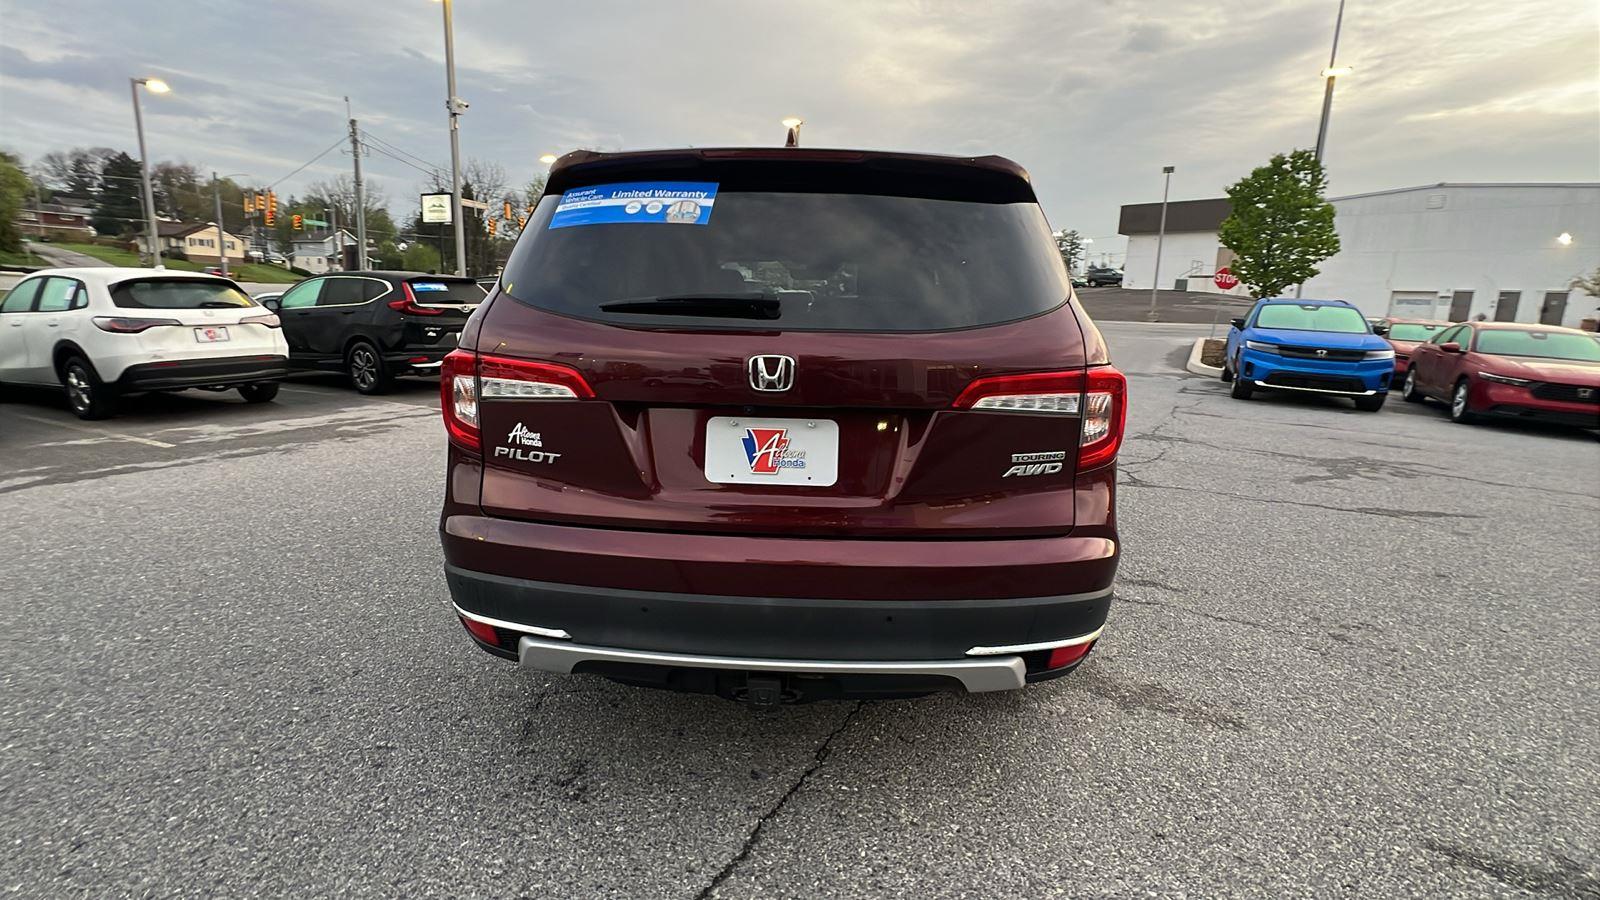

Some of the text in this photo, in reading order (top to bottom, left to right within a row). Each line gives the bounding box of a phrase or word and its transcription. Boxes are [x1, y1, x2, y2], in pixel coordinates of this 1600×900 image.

[611, 189, 708, 200] Limited Warranty
[494, 446, 562, 465] PILOT
[1013, 452, 1065, 462] TOURING
[1002, 462, 1063, 478] AWD
